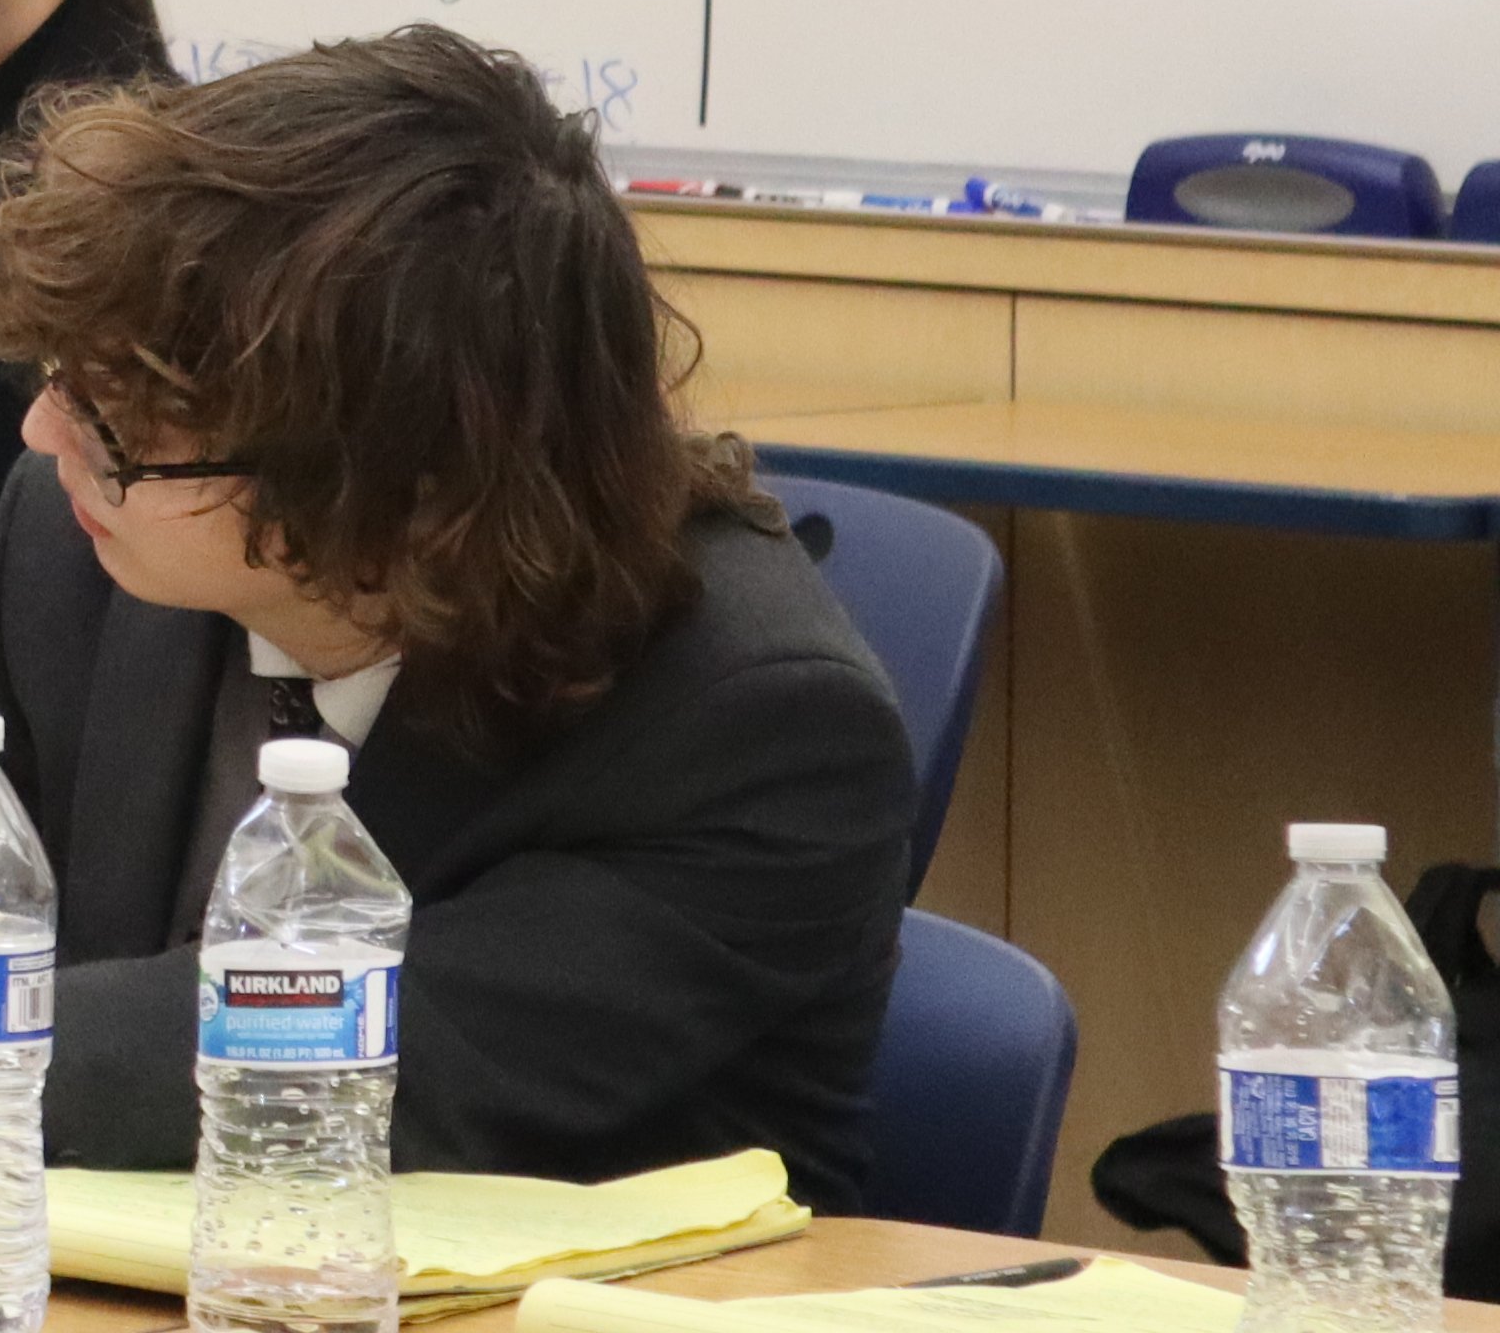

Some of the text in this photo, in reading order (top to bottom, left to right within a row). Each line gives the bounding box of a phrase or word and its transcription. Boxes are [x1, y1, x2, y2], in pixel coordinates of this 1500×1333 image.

[230, 976, 340, 995] KIRKLAND
[226, 1014, 345, 1032] purified water
